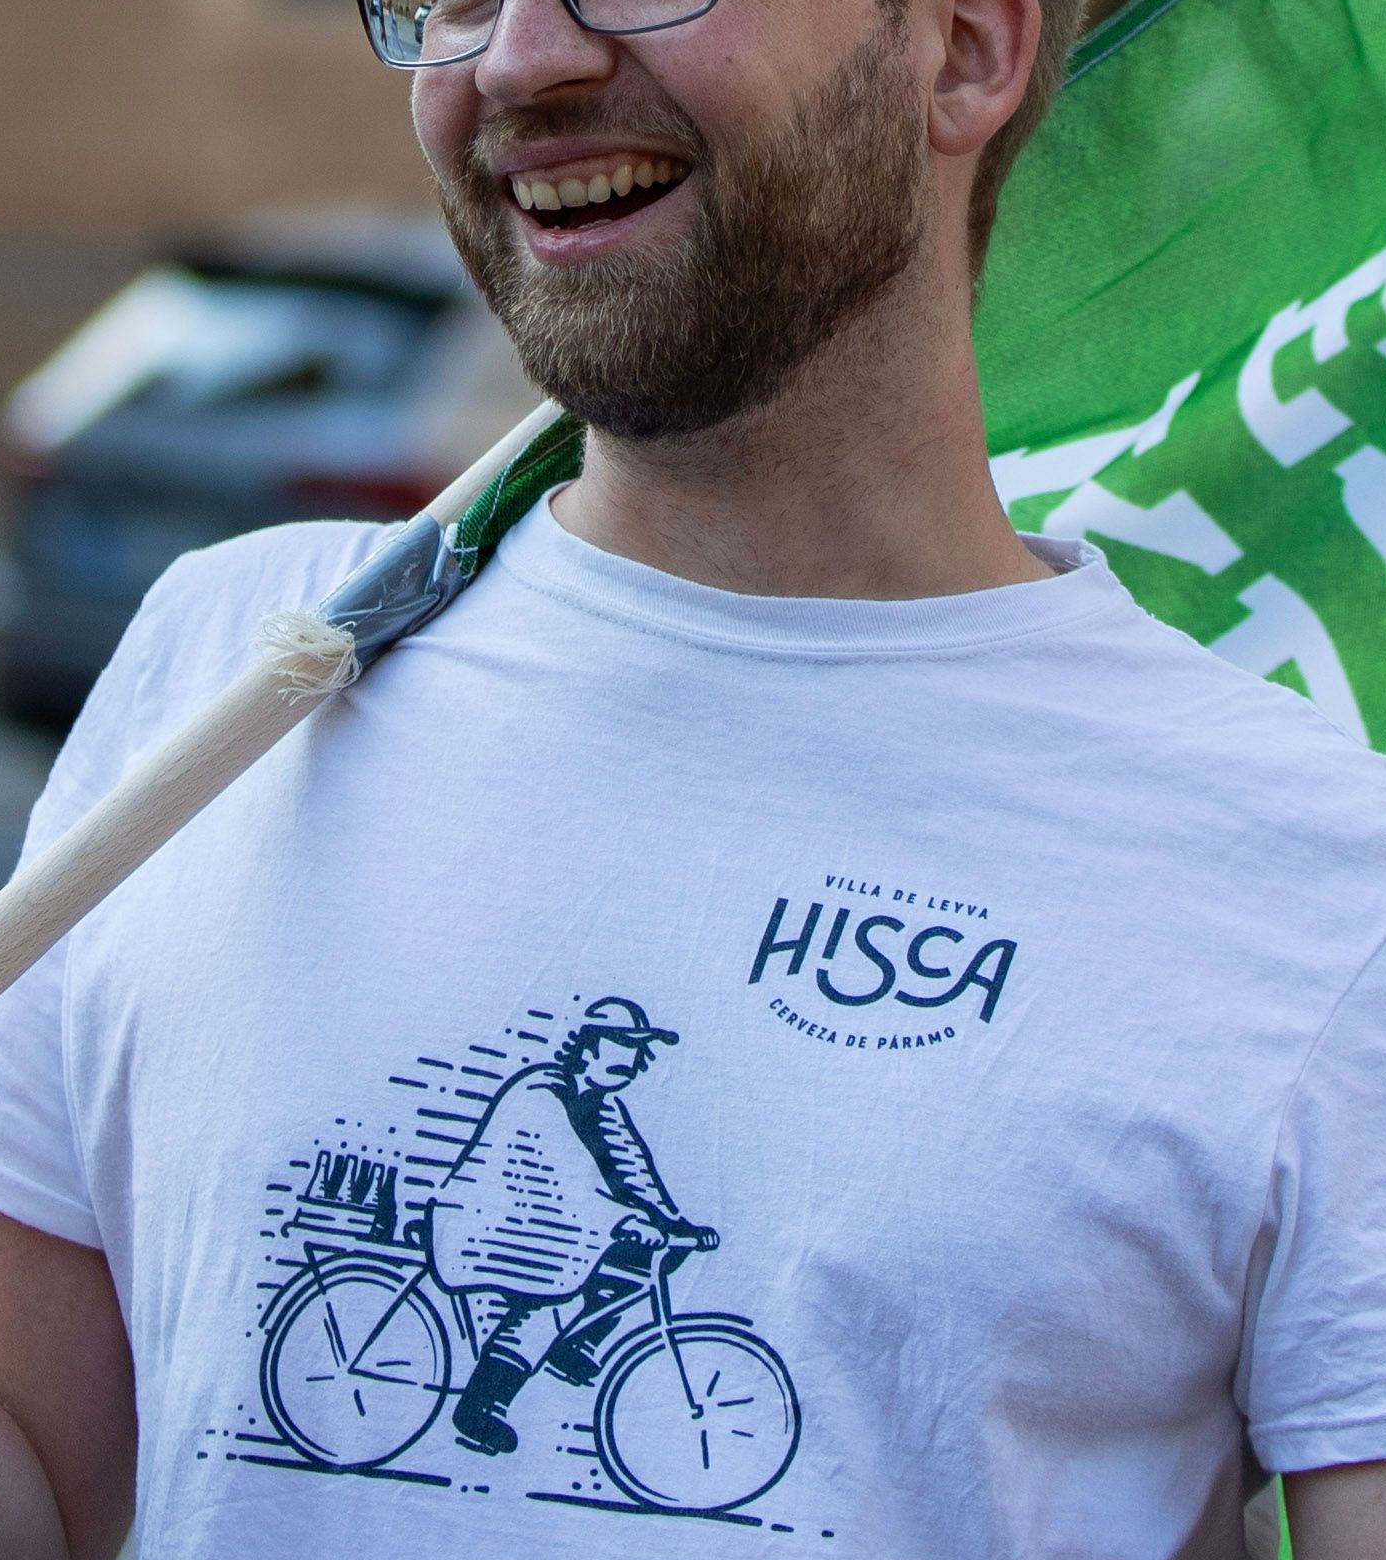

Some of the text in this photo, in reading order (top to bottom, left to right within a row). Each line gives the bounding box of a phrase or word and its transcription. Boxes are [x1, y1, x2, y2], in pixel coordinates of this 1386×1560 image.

[825, 874, 989, 920] VILLA DE LEYVA
[747, 897, 1018, 1025] HISCA
[769, 998, 956, 1050] CERVEZA DE PÁRAMO
